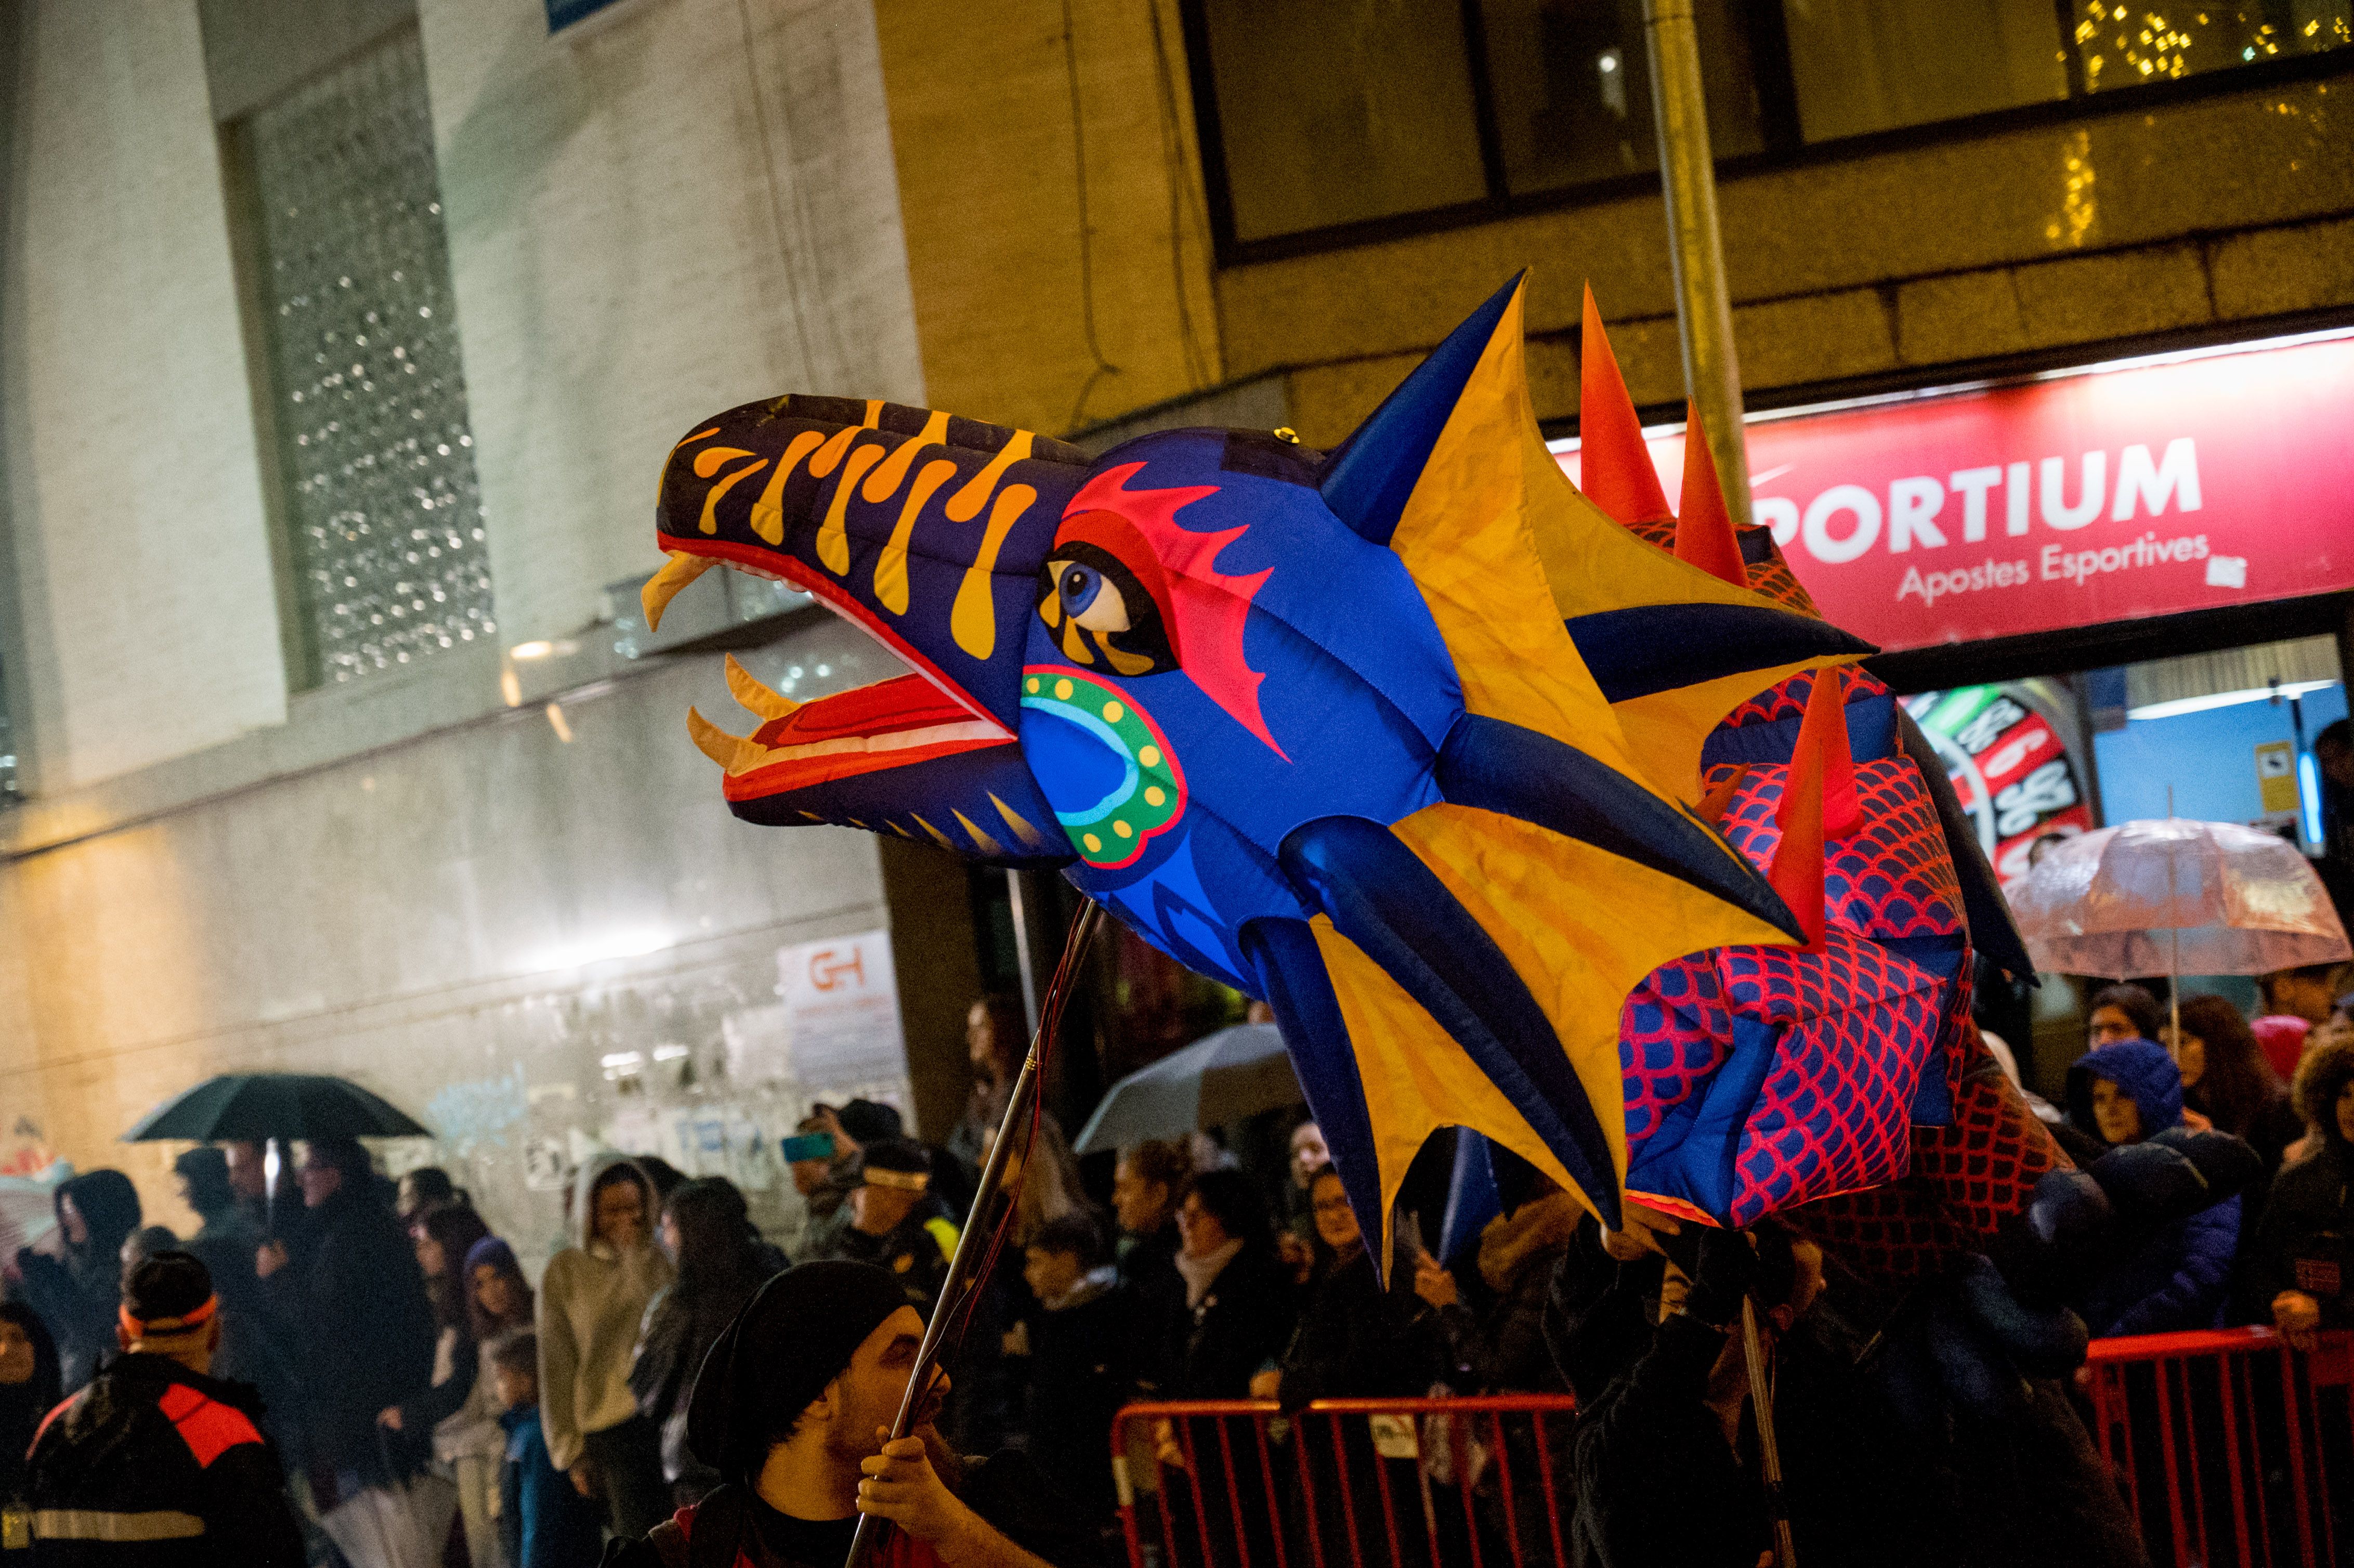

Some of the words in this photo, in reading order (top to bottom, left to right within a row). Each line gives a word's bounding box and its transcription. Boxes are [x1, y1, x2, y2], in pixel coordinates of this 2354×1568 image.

[1751, 437, 2203, 564] PORTIUM
[1897, 564, 2029, 608] Apostes
[2041, 531, 2210, 586] Esportives
